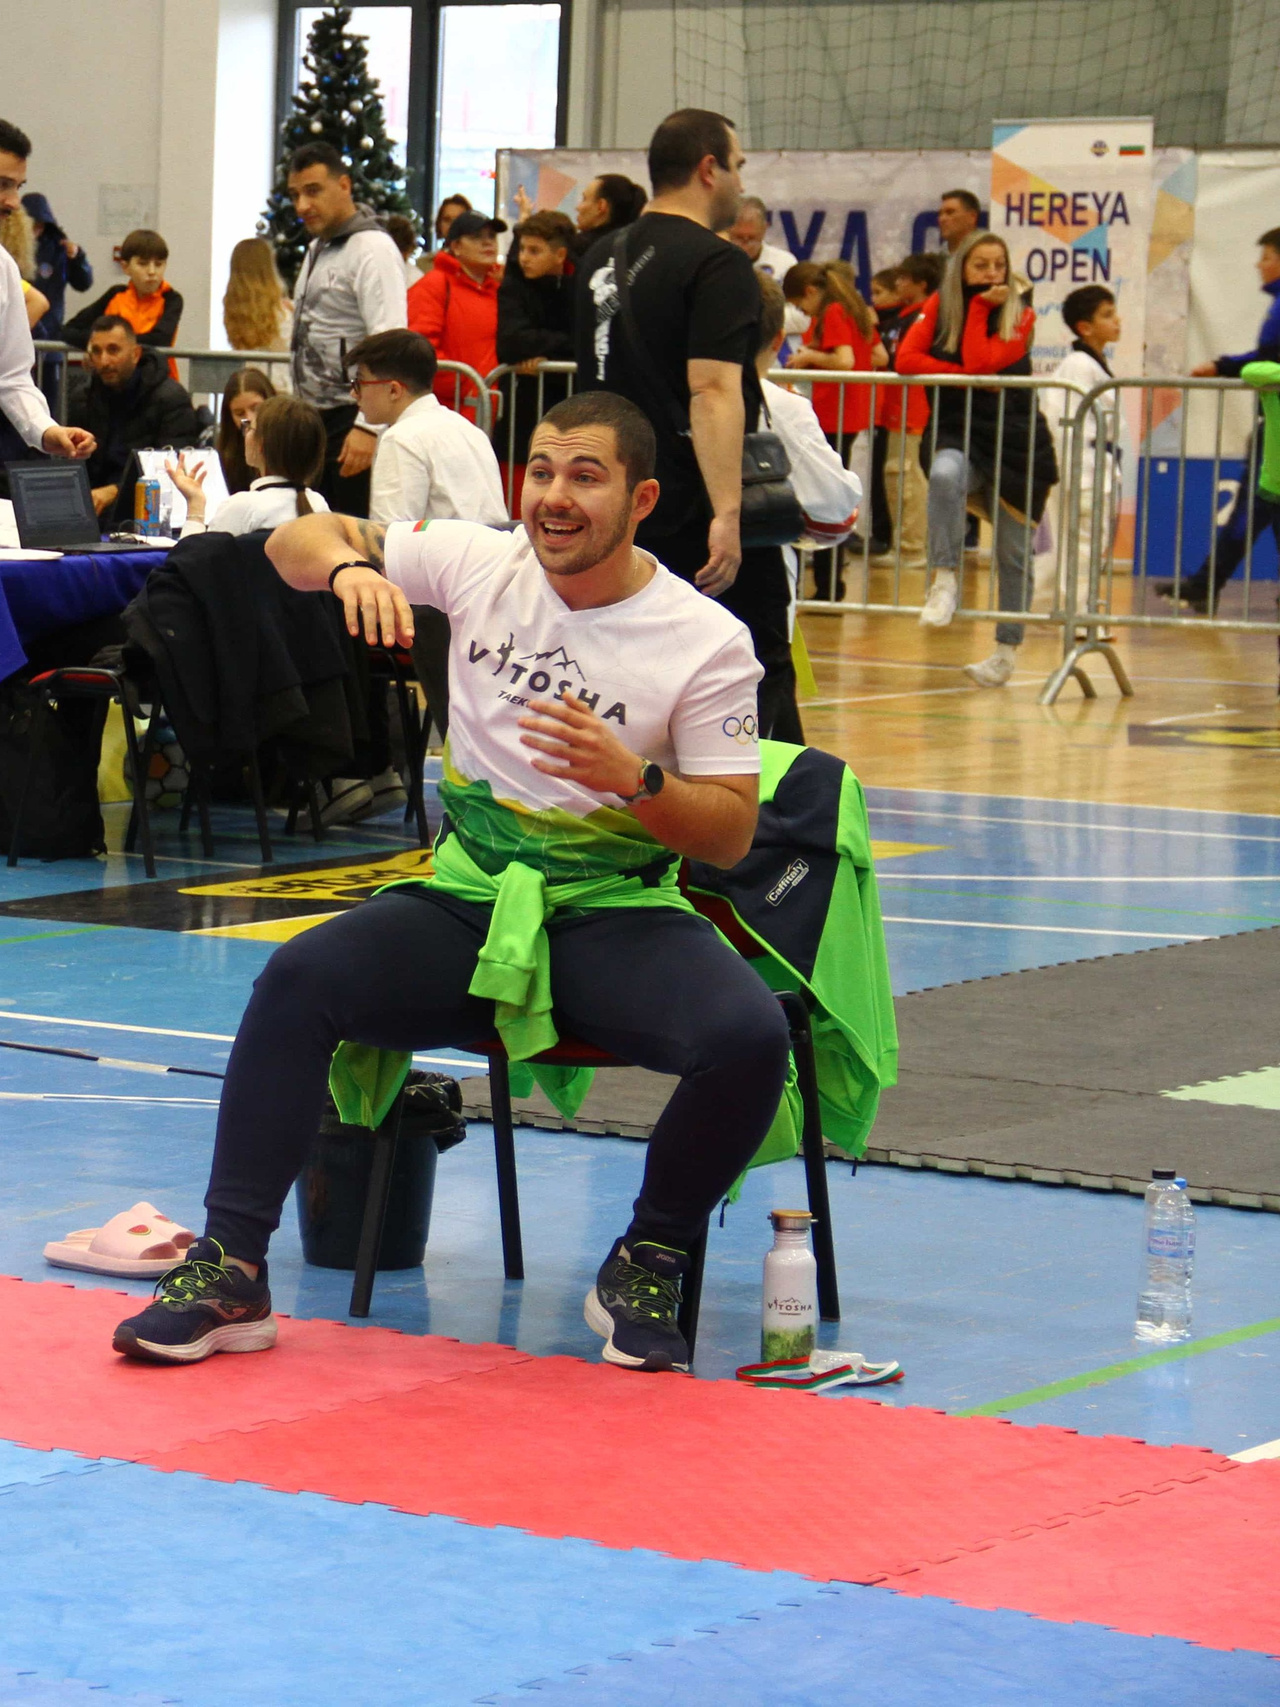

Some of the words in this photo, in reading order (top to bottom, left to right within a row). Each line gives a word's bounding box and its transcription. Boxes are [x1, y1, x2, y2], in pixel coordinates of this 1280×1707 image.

[1005, 191, 1131, 227] HEREYA
[1026, 247, 1111, 283] OPEN
[497, 690, 530, 708] TAEK
